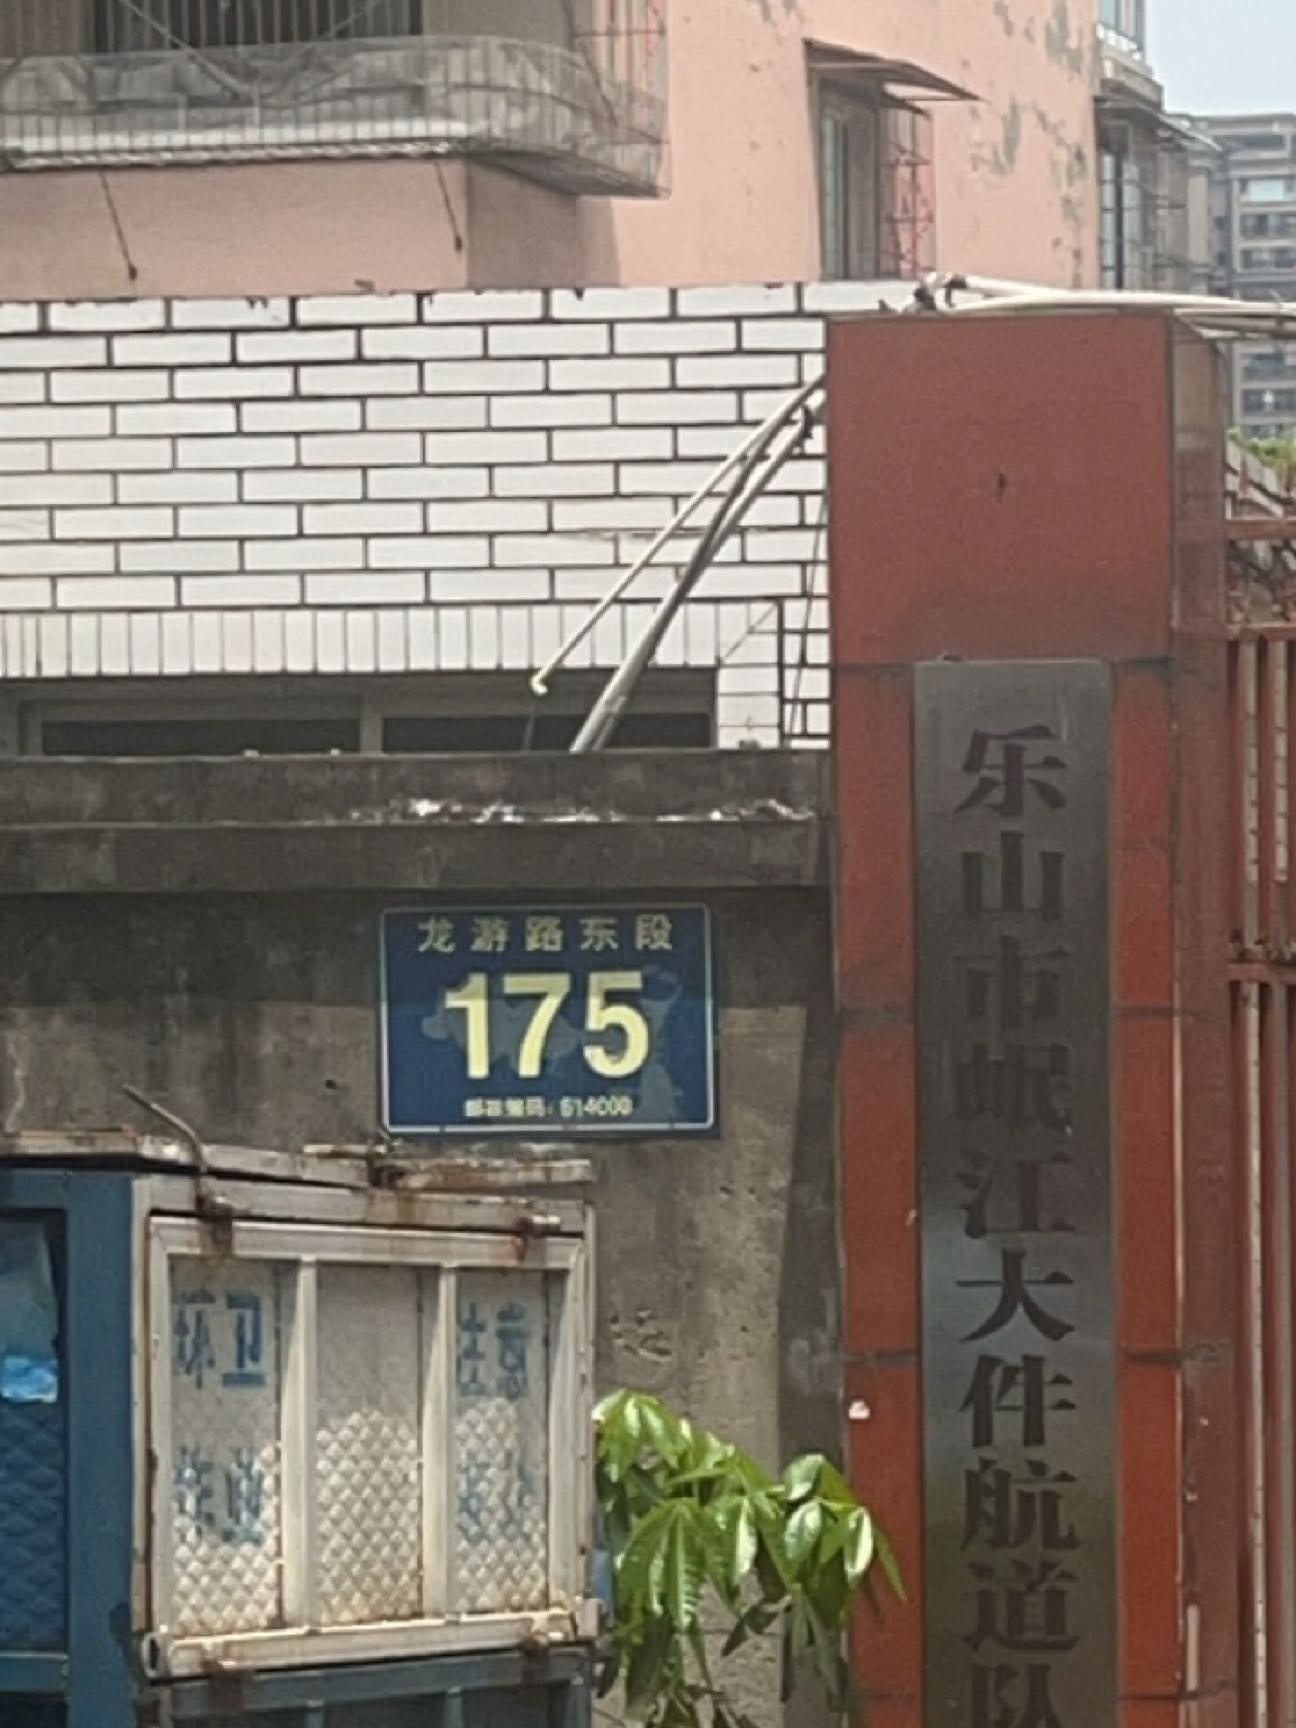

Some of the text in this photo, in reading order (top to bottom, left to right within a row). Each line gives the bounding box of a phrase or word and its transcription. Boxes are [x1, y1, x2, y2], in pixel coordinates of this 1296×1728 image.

[417, 915, 672, 951] 龙游路东段
[444, 971, 649, 1079] 175
